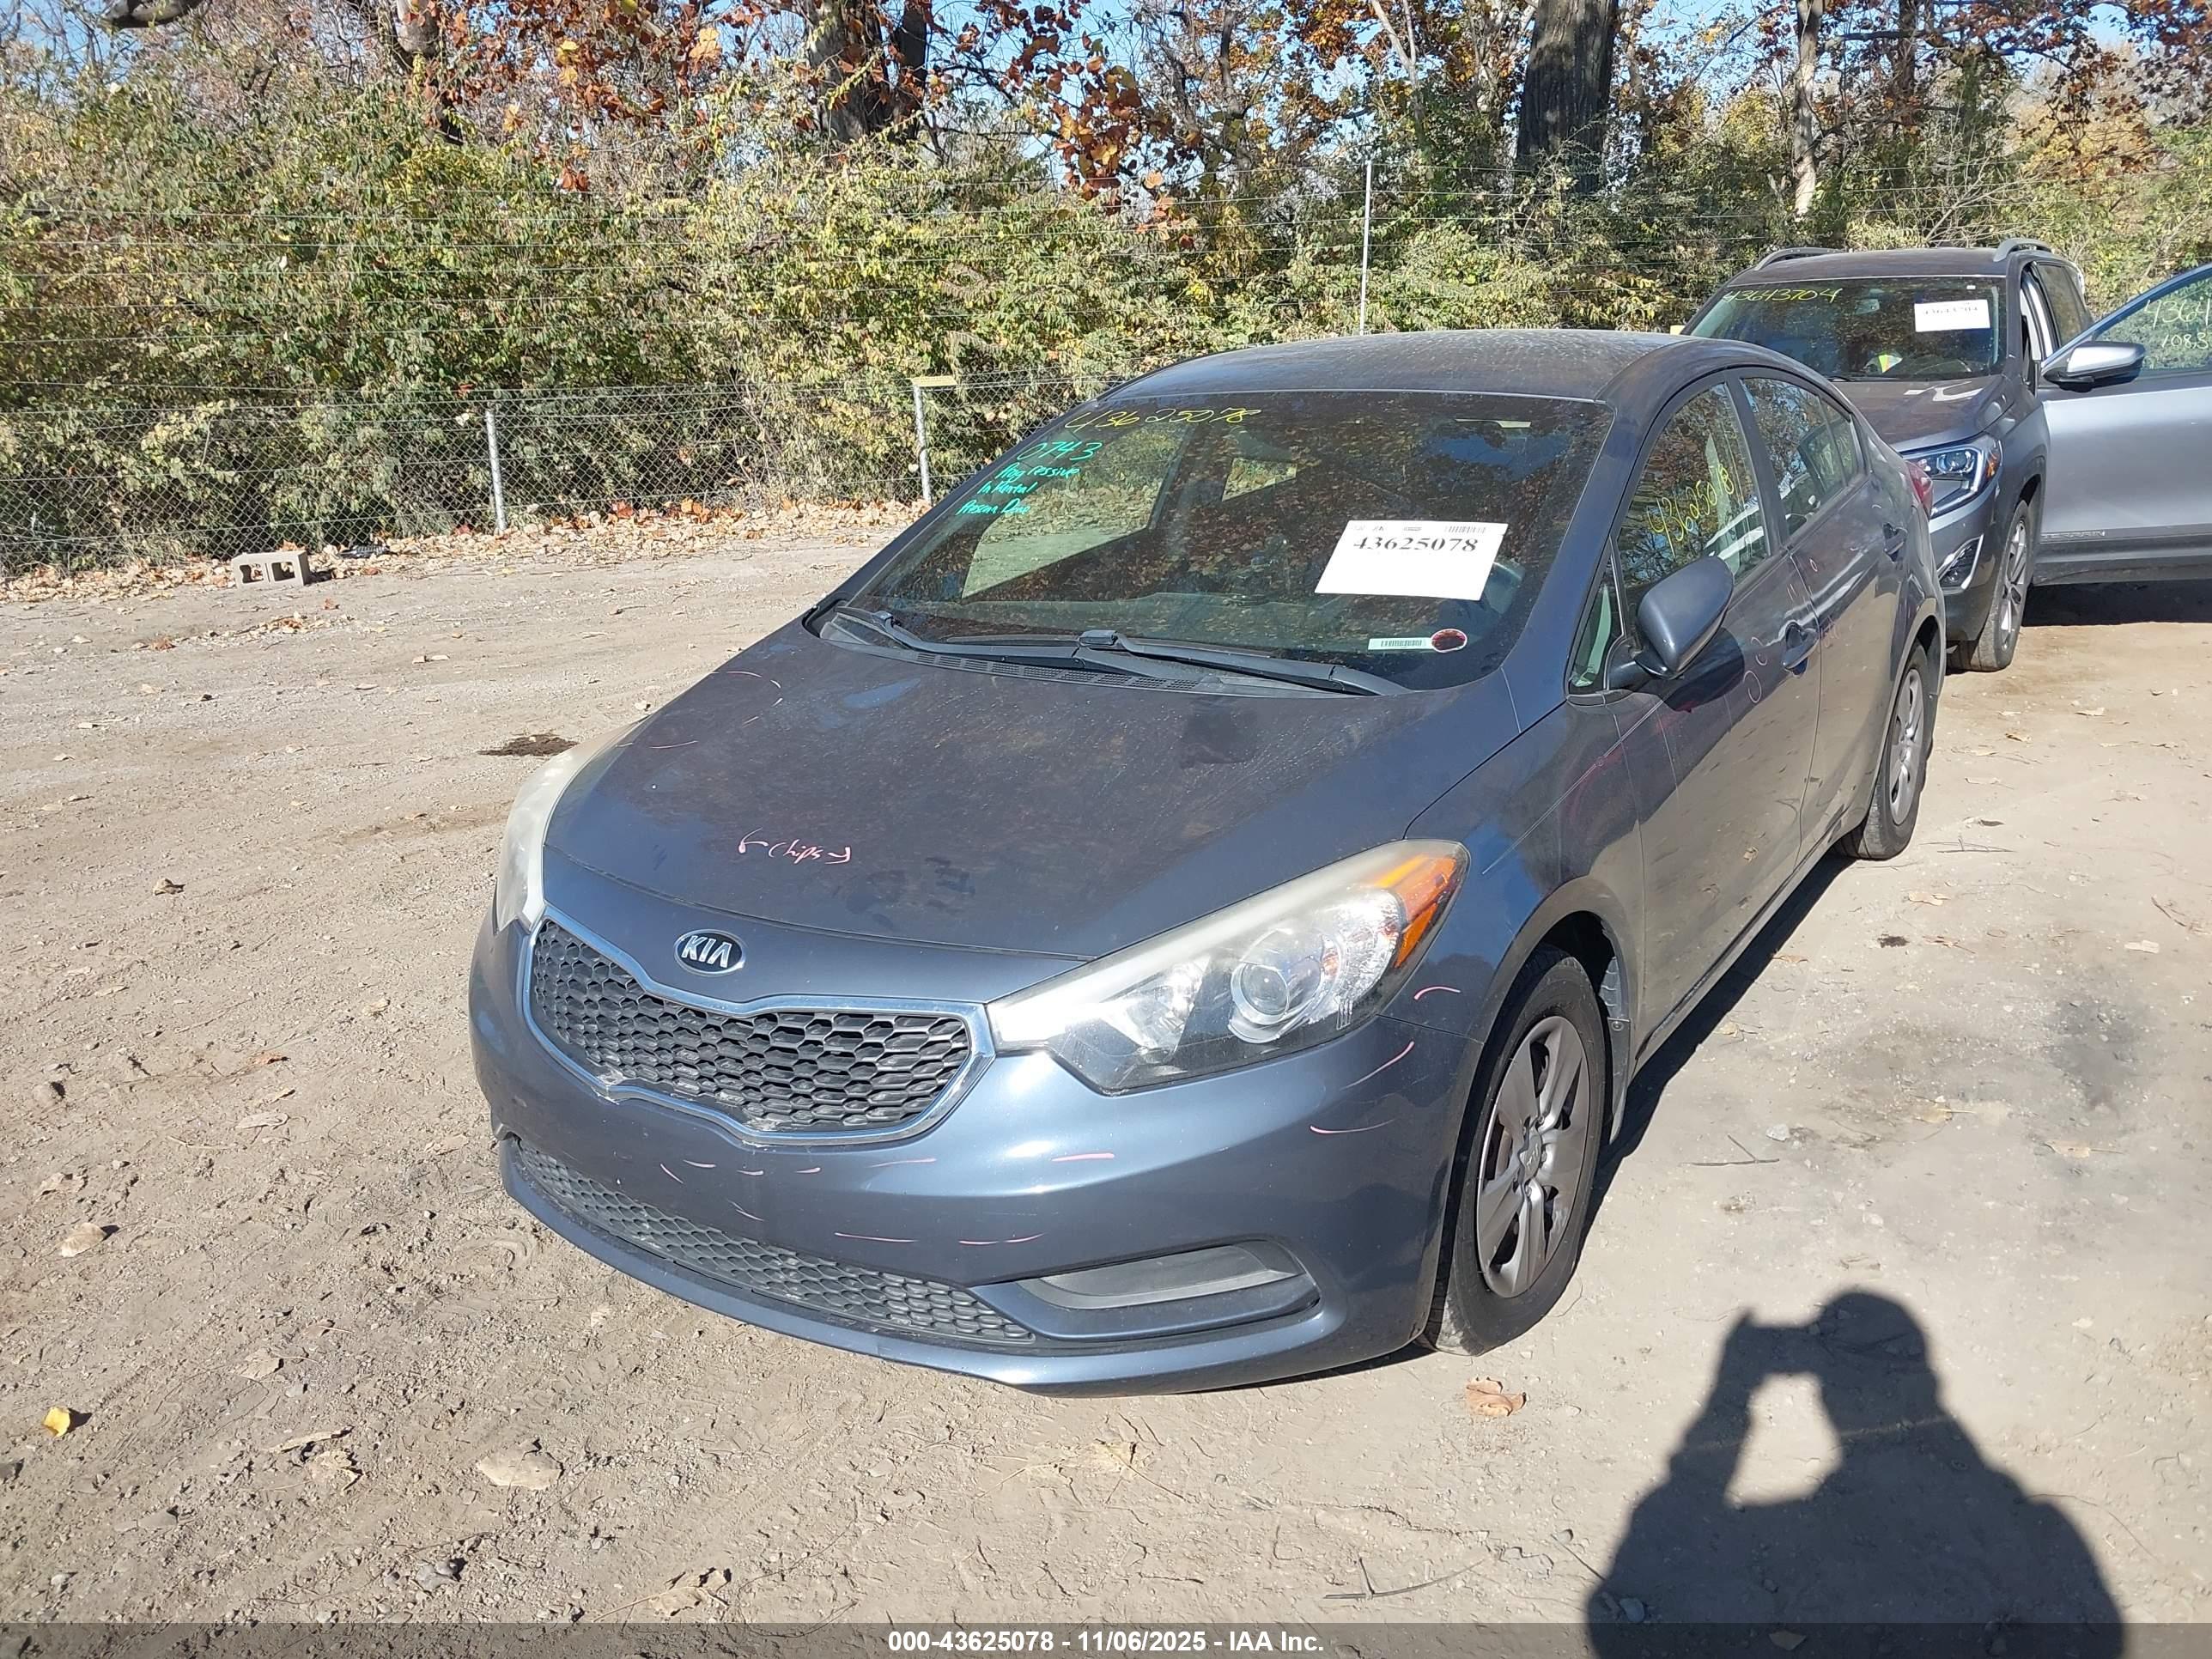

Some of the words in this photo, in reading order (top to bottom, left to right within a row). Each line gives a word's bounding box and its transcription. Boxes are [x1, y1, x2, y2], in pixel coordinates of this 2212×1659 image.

[1723, 288, 1844, 303] 43643704
[2143, 298, 2212, 330] 4364
[2161, 331, 2212, 349] 108,3
[1064, 407, 1262, 433] 43625078
[1016, 441, 1103, 461] 0743
[1353, 536, 1479, 552] 43625078
[681, 934, 732, 969] KIA
